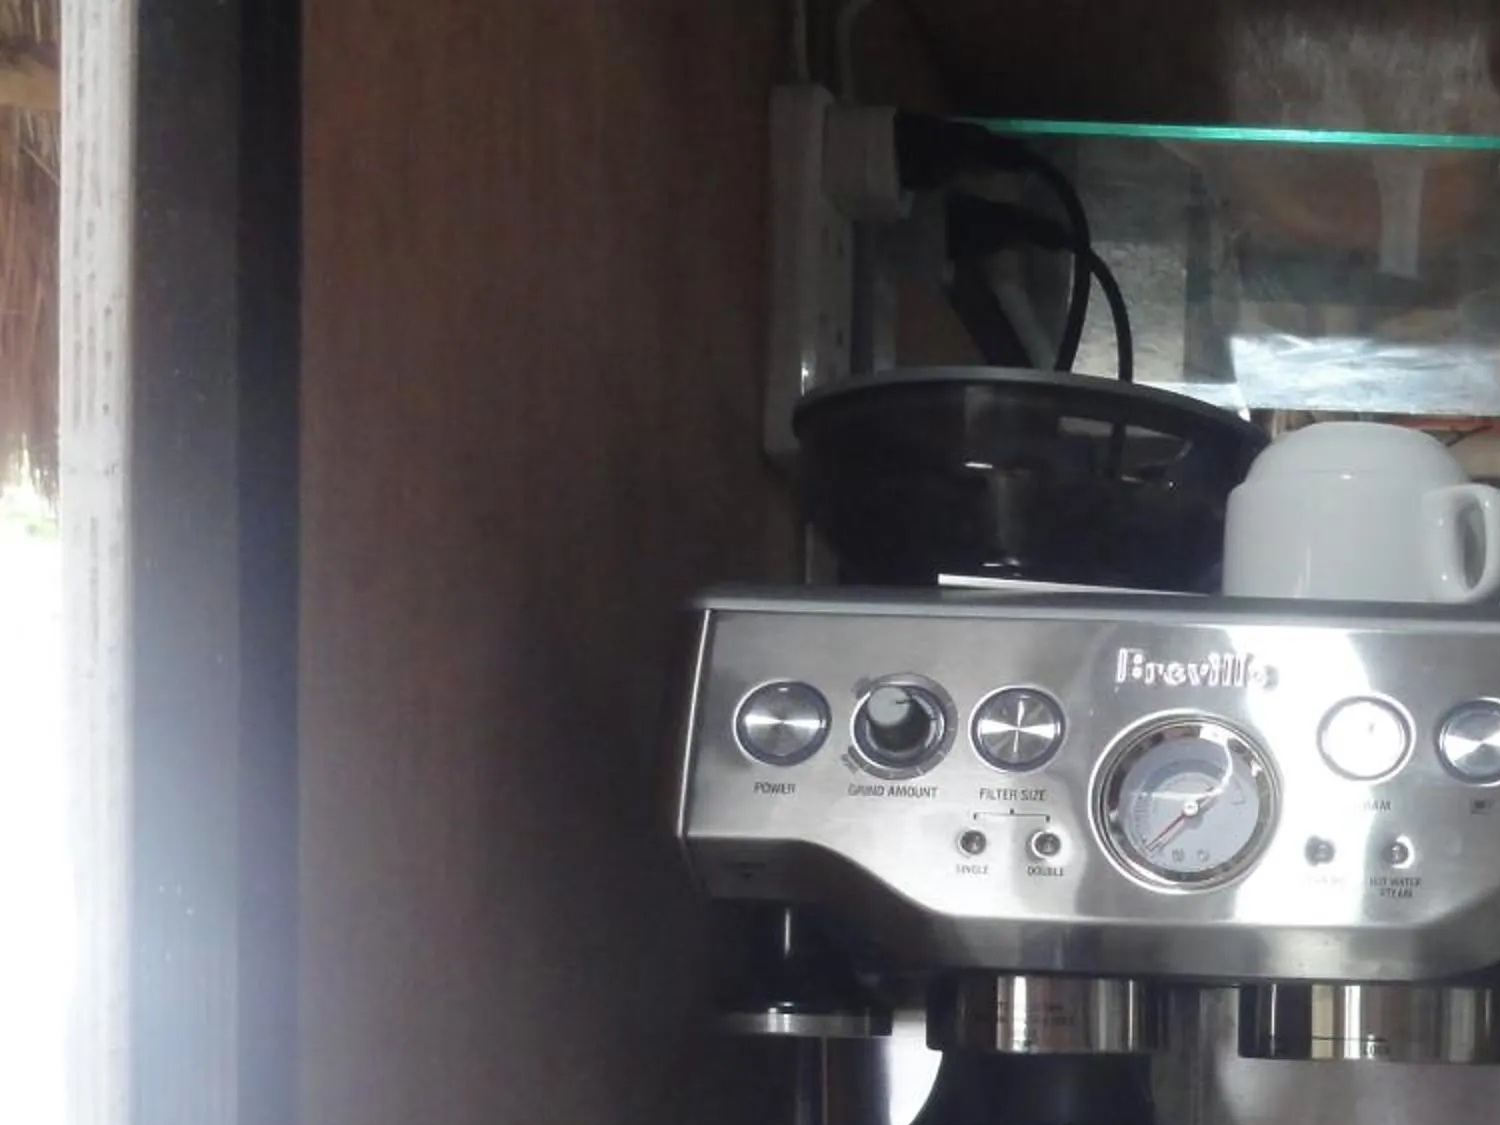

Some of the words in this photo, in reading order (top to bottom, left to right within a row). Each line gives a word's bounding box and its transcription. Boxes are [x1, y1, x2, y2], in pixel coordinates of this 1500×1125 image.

[754, 781, 796, 796] POWER
[848, 783, 884, 798] GRIND
[887, 784, 939, 799] AMOUNT
[979, 787, 1017, 801] FILTER
[1020, 788, 1047, 801] SIZE
